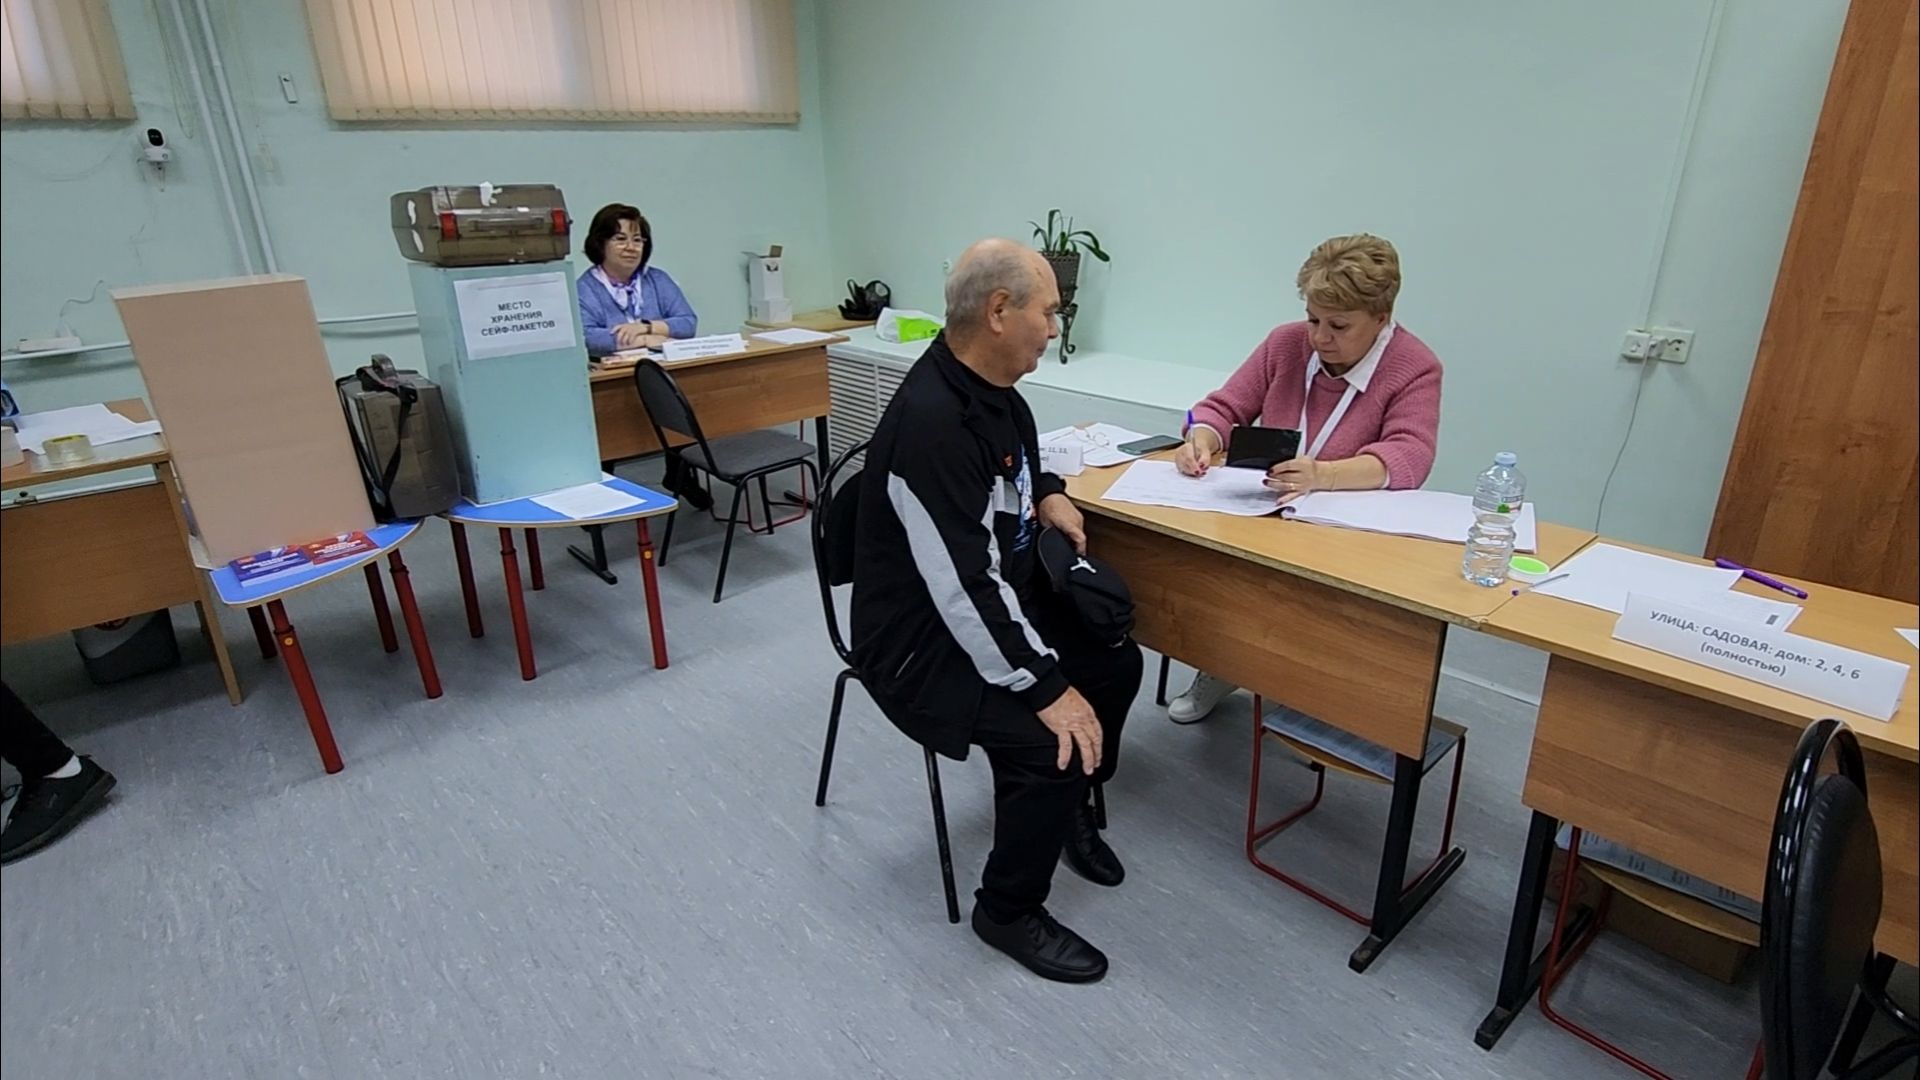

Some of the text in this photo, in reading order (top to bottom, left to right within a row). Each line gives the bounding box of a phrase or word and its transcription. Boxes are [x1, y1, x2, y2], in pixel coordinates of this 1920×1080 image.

[498, 300, 531, 311] МЕСТО
[491, 310, 543, 323] ХРАНЕНИЯ
[481, 320, 555, 336] СЕЙФ-ПАКЕТОВ
[1650, 610, 1861, 680] УЛИЦА: САДОВАЯ: дом: 2, 4, 6
[1700, 641, 1787, 677] (полностью)
